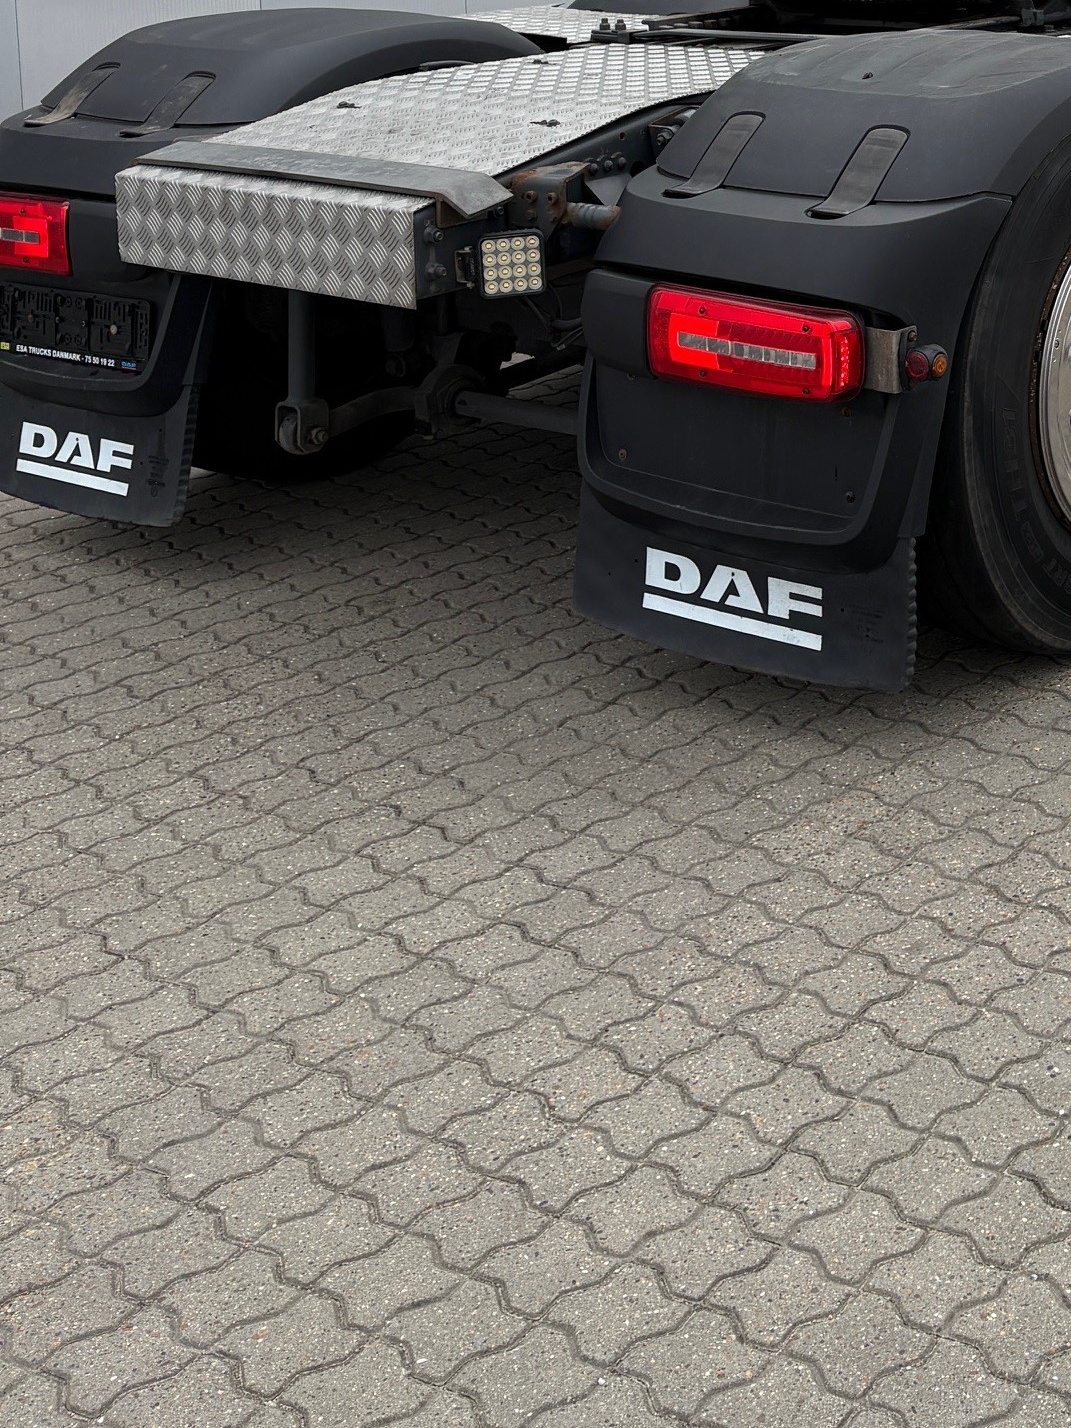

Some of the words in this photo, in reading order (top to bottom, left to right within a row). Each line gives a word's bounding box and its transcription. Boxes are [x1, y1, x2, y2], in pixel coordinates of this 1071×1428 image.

[16, 344, 28, 353] ESA
[28, 346, 52, 357] TRUCKS
[52, 349, 81, 362] DANMARK
[107, 358, 115, 367] 22
[18, 421, 135, 473] DAF
[645, 546, 823, 621] DAF
